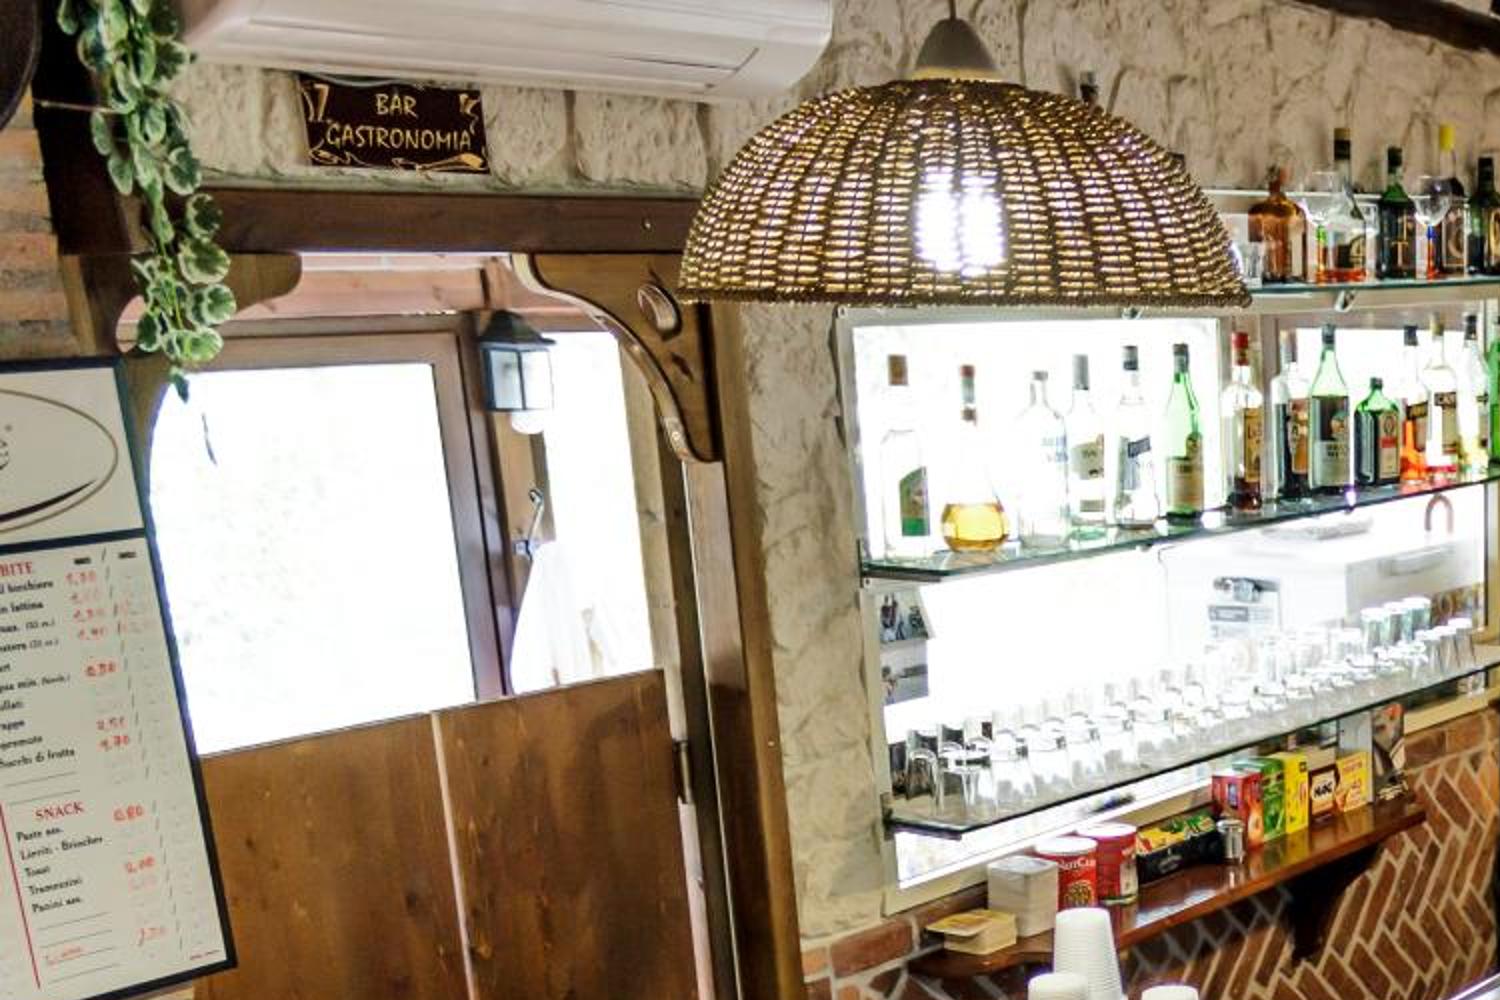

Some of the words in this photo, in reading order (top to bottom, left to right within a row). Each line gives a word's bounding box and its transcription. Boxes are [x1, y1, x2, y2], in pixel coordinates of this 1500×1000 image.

[376, 92, 418, 117] BAR
[325, 122, 472, 151] GASTRONOMIA
[35, 801, 85, 820] SNACK
